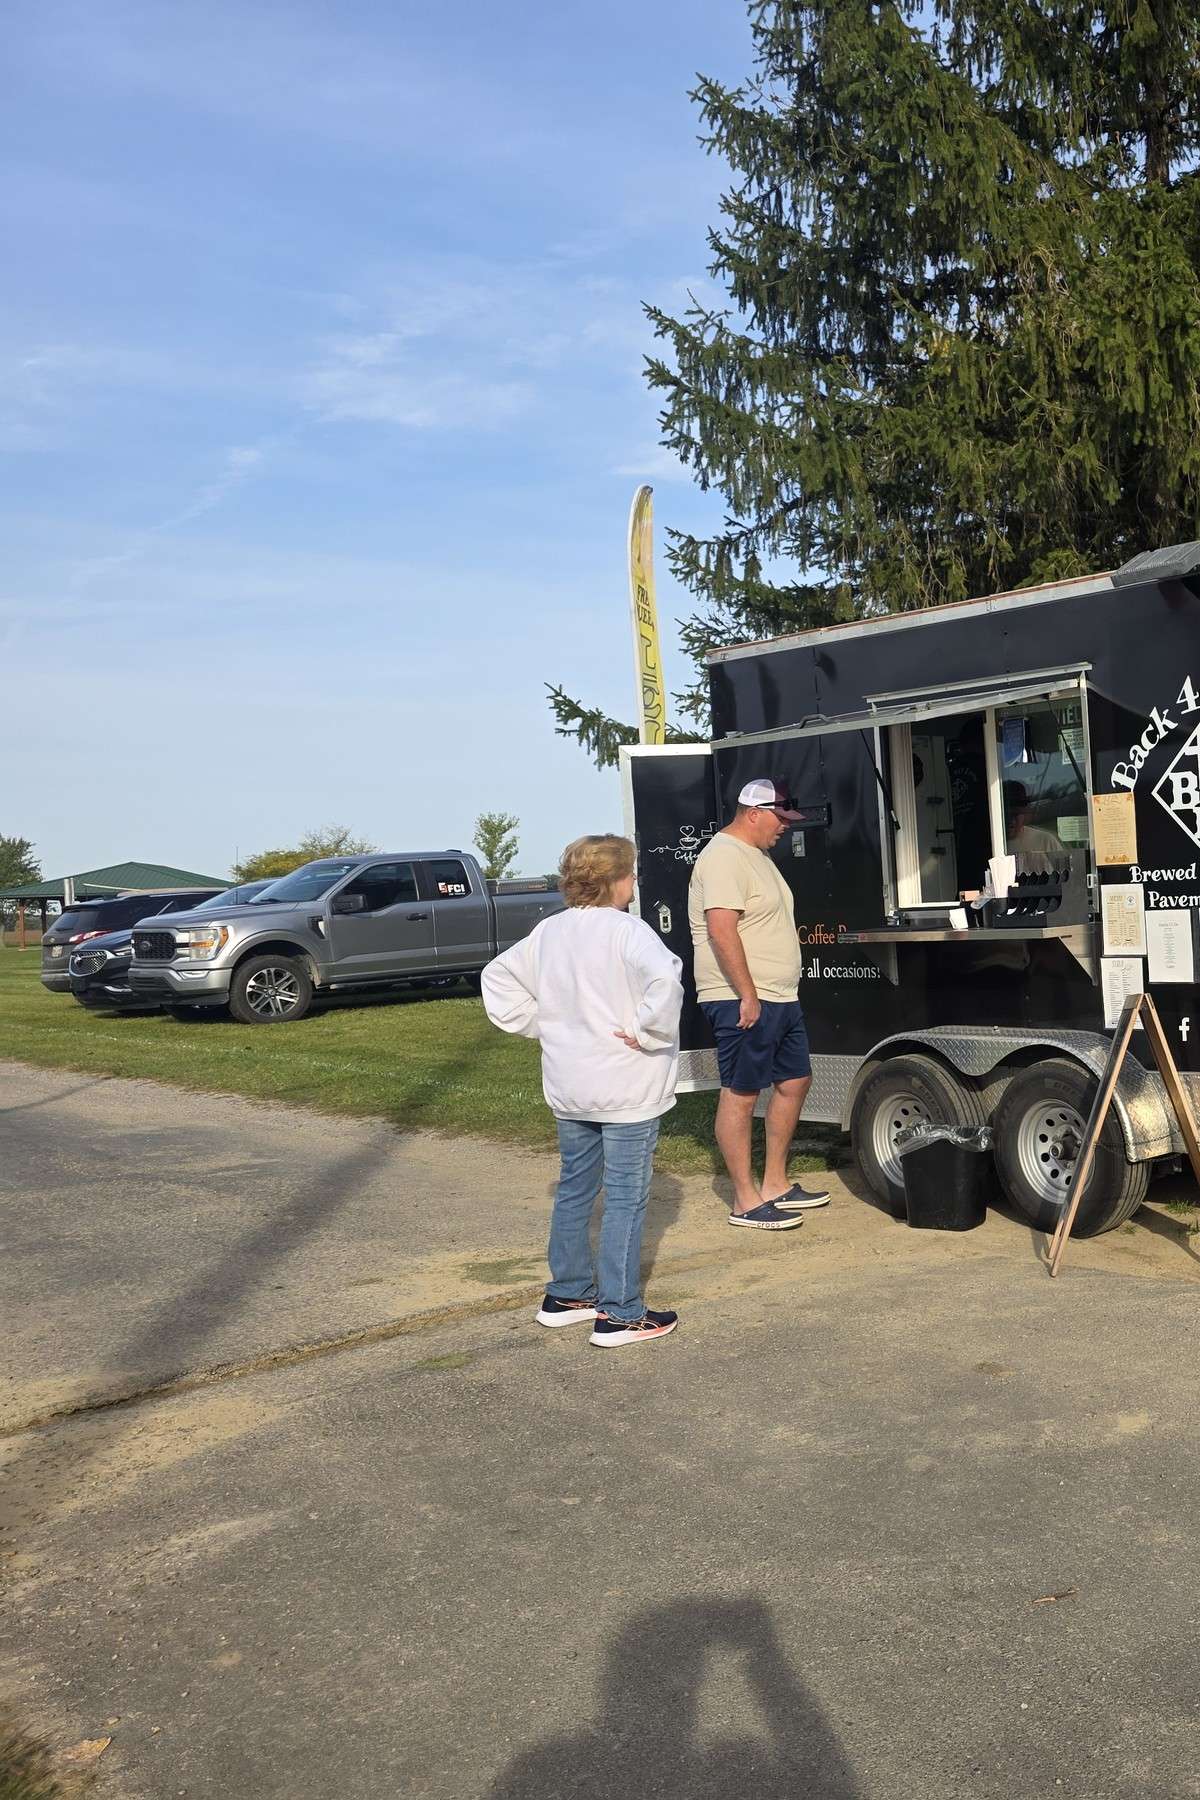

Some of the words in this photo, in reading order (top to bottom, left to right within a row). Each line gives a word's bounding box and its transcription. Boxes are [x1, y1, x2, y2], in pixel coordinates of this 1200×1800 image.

[1111, 706, 1178, 791] Back
[1129, 863, 1197, 883] Brewed
[448, 884, 465, 892] FCI
[797, 924, 835, 945] Coffee
[807, 957, 820, 978] all
